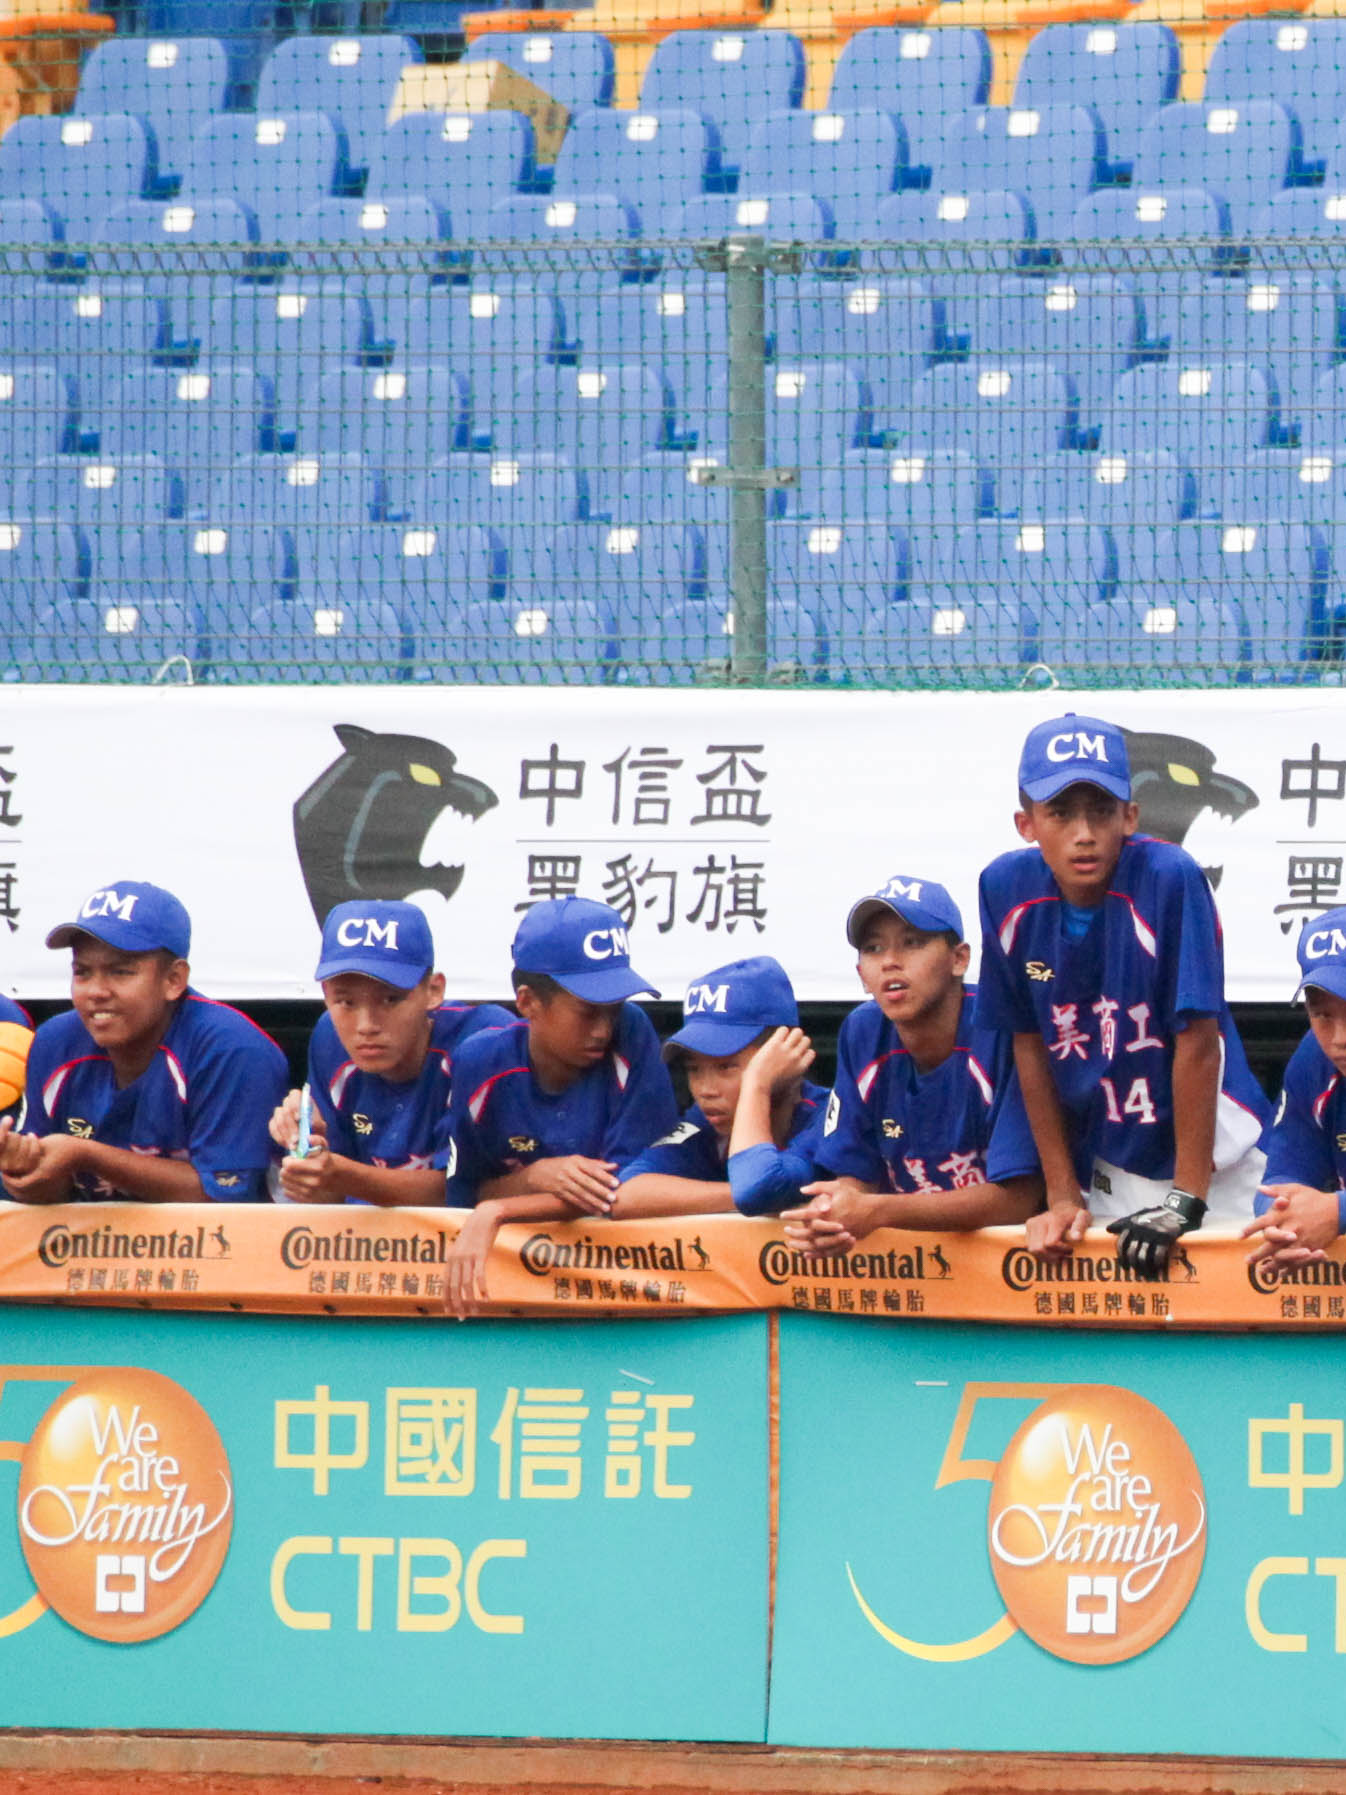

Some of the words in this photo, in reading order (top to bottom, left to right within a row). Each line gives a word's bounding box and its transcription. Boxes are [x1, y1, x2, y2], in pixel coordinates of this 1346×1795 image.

[1047, 733, 1109, 763] CM
[520, 743, 772, 827] 中信盃
[81, 890, 139, 921] CM
[514, 853, 768, 934] 黑豹旗
[880, 879, 923, 903] M
[337, 918, 399, 951] CM
[684, 984, 730, 1013] CM
[1100, 1078, 1157, 1123] 14
[38, 1224, 206, 1268] Continental
[281, 1226, 447, 1270] Continental
[520, 1233, 687, 1276] Continental
[792, 1286, 926, 1312] 德國馬牌輪胎
[1034, 1291, 1170, 1316] 德國馬牌輪胎
[88, 1404, 158, 1458] We
[274, 1385, 696, 1500] 中國信託
[1059, 1423, 1130, 1476] We
[118, 1454, 180, 1492] are
[1091, 1475, 1152, 1512] are
[21, 1453, 231, 1582] Family
[991, 1471, 1205, 1603] Family
[270, 1536, 528, 1634] CTBC
